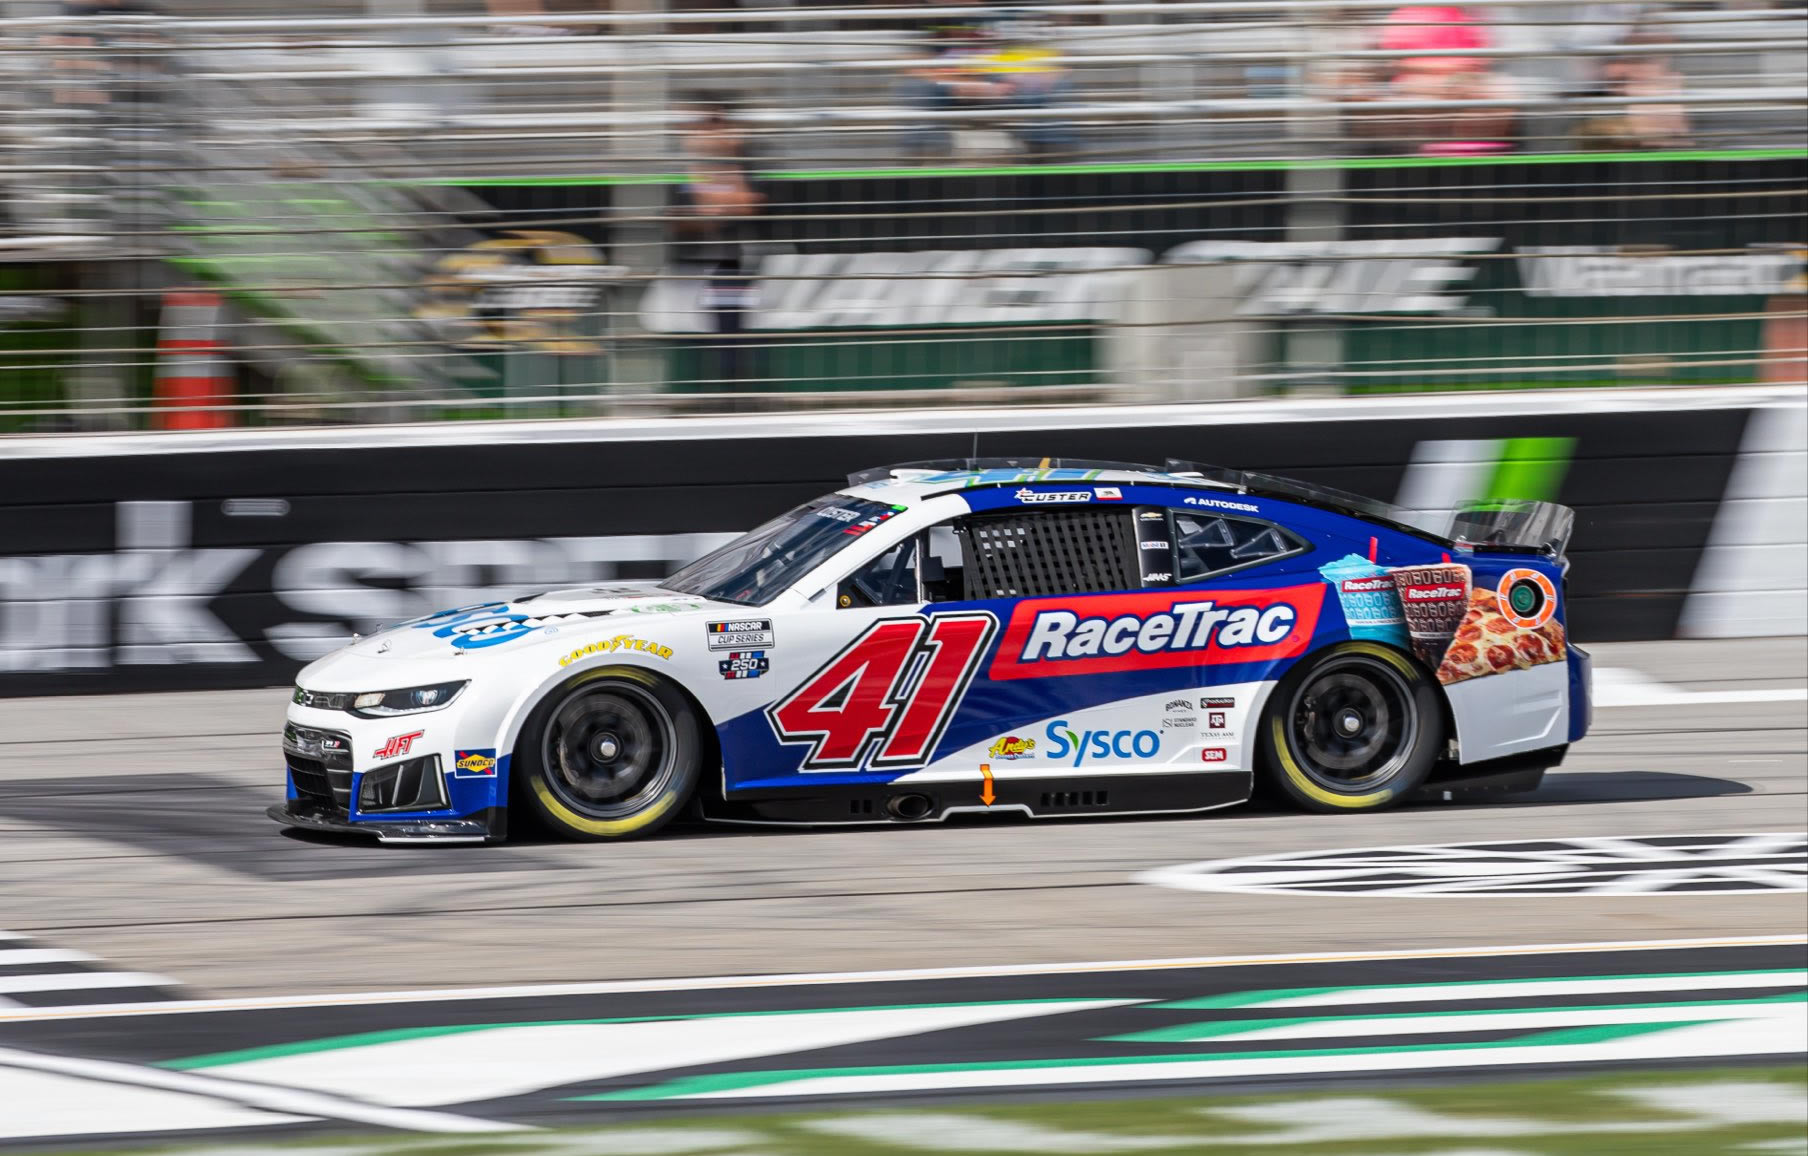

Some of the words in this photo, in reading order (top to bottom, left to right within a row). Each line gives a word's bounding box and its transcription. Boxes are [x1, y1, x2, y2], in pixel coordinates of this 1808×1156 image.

[1019, 492, 1090, 503] CUSTER
[1197, 499, 1260, 513] AUTODESK
[1408, 586, 1463, 599] RaceTrac
[728, 621, 763, 633] NASCAR
[1022, 602, 1294, 660] RaceTrac
[718, 635, 734, 644] CUP
[735, 633, 765, 643] SERIES
[559, 635, 674, 667] GOODYEAR
[731, 658, 758, 671] 250
[764, 610, 1000, 773] 41
[1046, 720, 1160, 767] Sysco
[457, 758, 496, 769] SUNOCO
